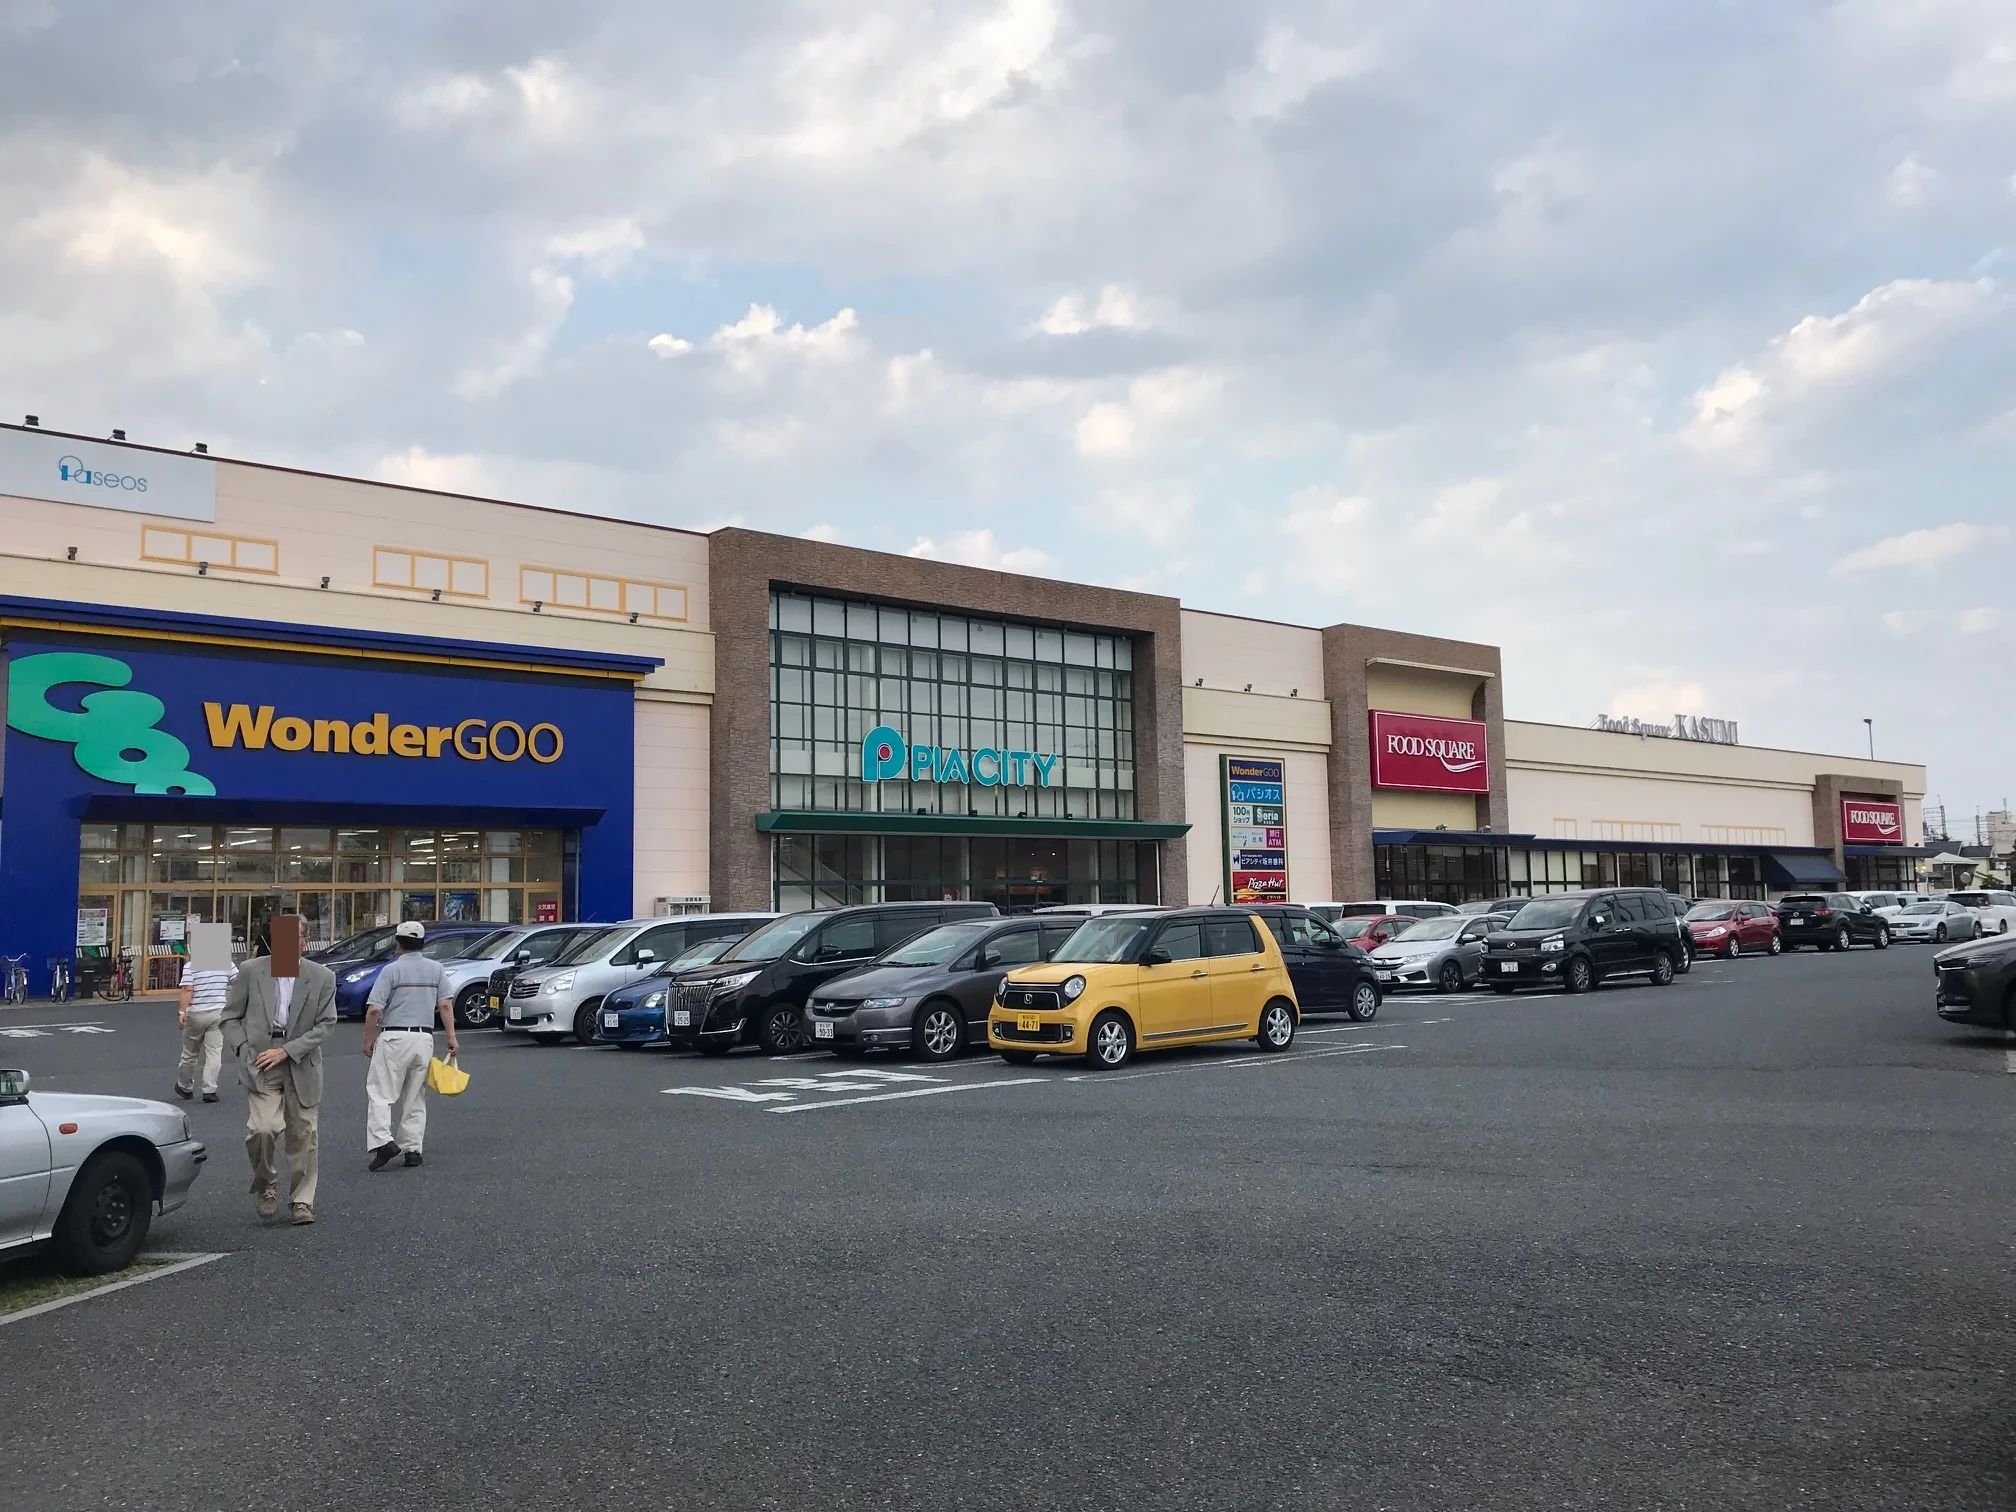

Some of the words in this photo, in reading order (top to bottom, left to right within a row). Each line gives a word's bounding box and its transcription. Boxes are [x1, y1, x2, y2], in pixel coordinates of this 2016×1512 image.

[203, 701, 564, 764] WonderGOO
[1598, 713, 1630, 733] Food
[1631, 717, 1673, 740] Square
[1674, 713, 1740, 745] KASUMI
[1386, 734, 1424, 756] FOOD
[1425, 738, 1478, 765] SQUARE
[1231, 765, 1280, 778] WonderGOO
[1245, 786, 1281, 800] パシオス
[1233, 816, 1250, 824] ショップ
[1850, 810, 1869, 824] FOOD
[1869, 811, 1896, 828] SQUARE
[1268, 838, 1282, 847] ATM
[1247, 877, 1268, 890] Pizza
[1268, 876, 1284, 888] Hut
